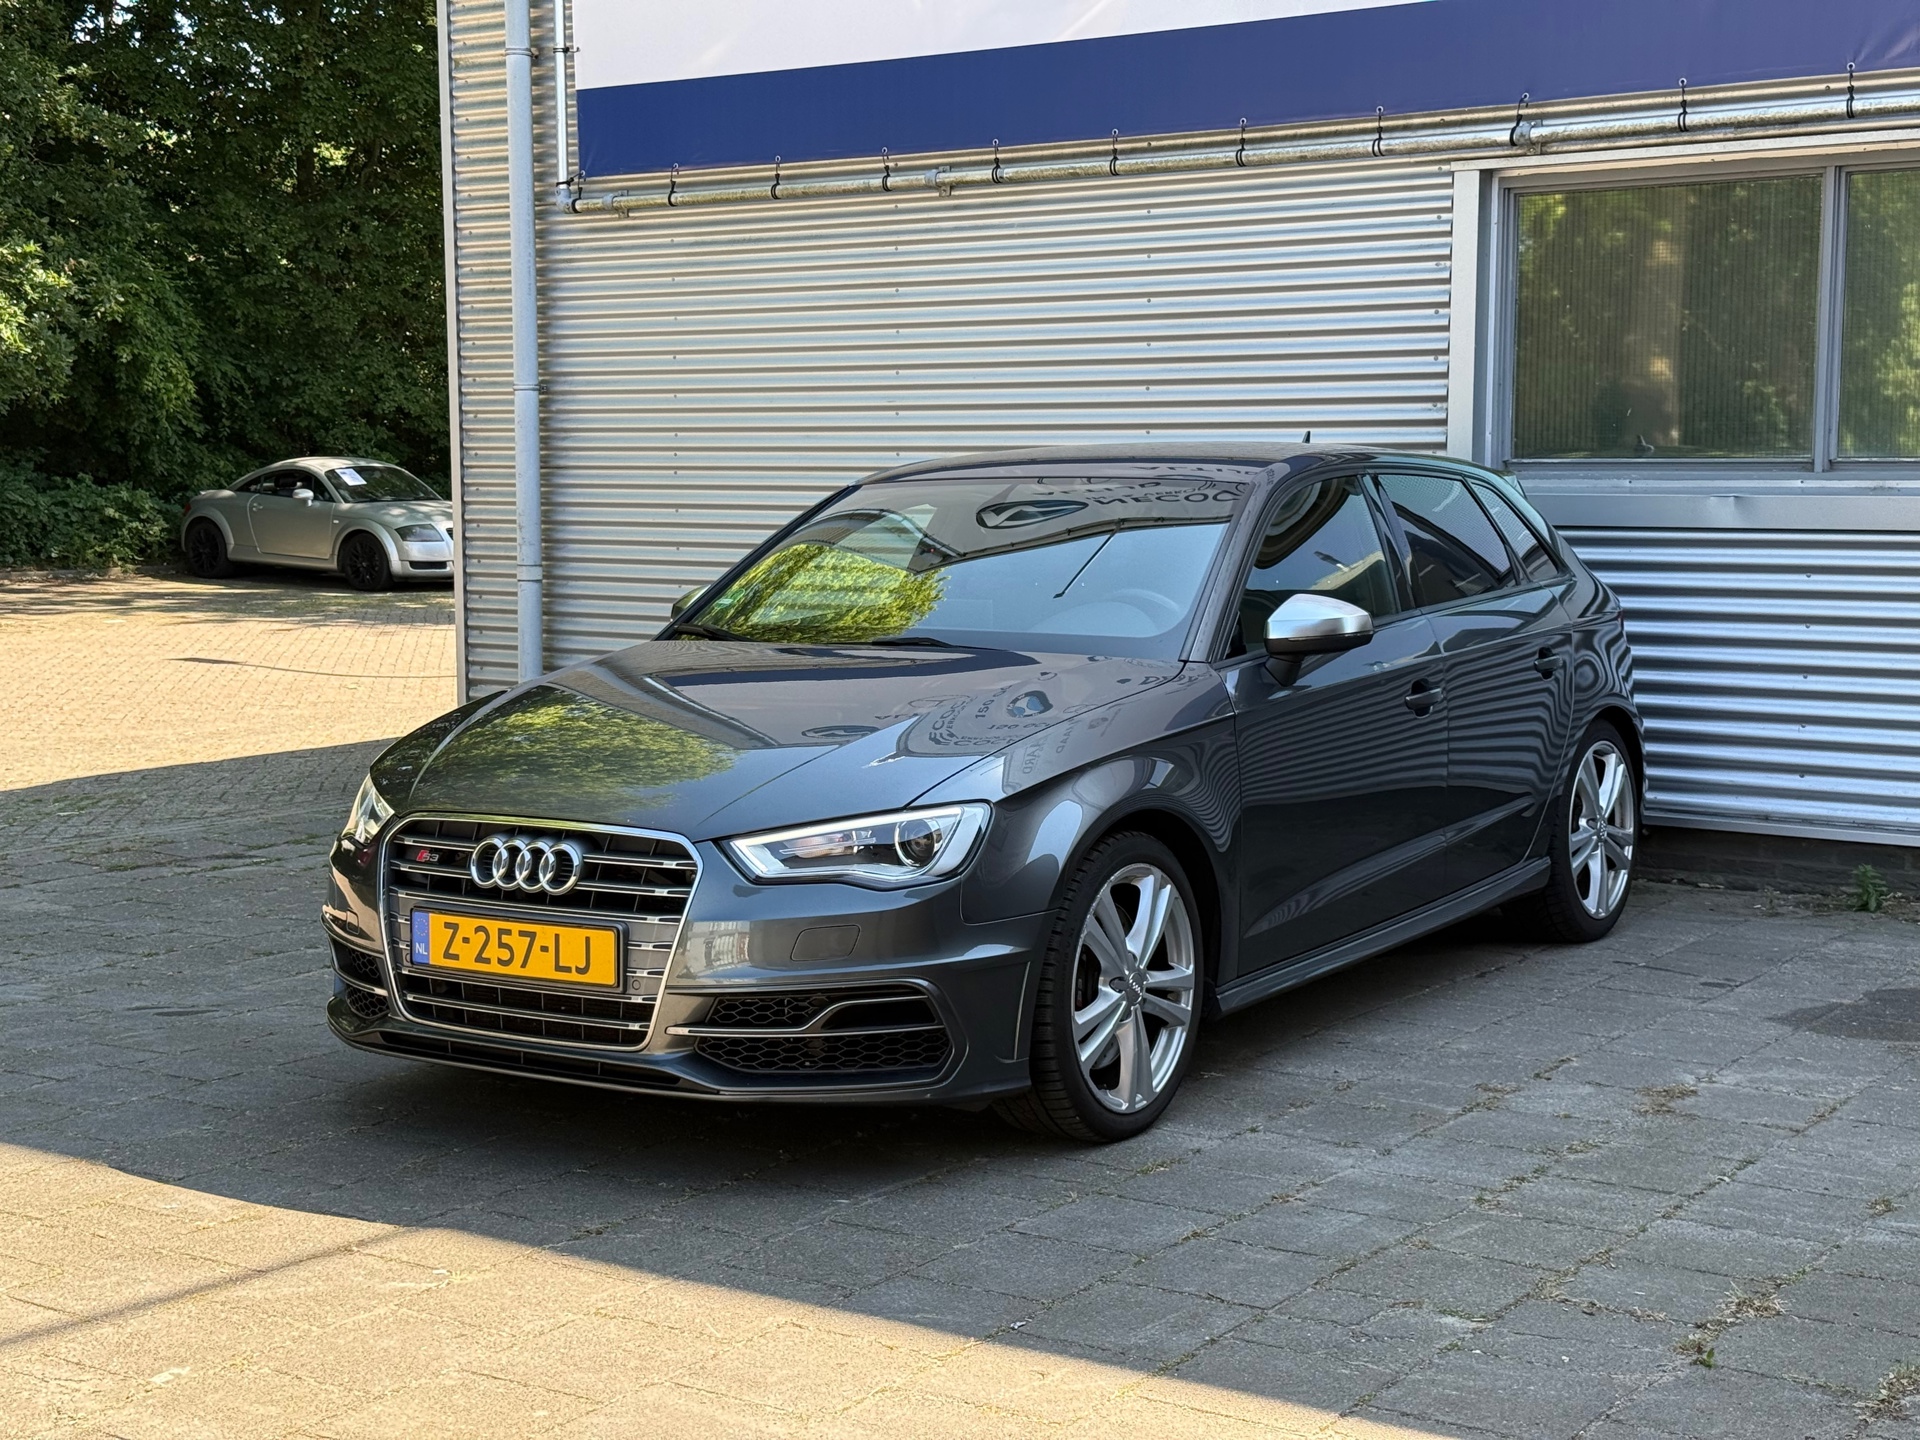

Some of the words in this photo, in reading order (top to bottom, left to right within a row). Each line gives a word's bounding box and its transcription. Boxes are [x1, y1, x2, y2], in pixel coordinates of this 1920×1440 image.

[420, 851, 439, 862] S3
[415, 942, 428, 955] NL
[443, 922, 591, 975] Z-257-LJ
